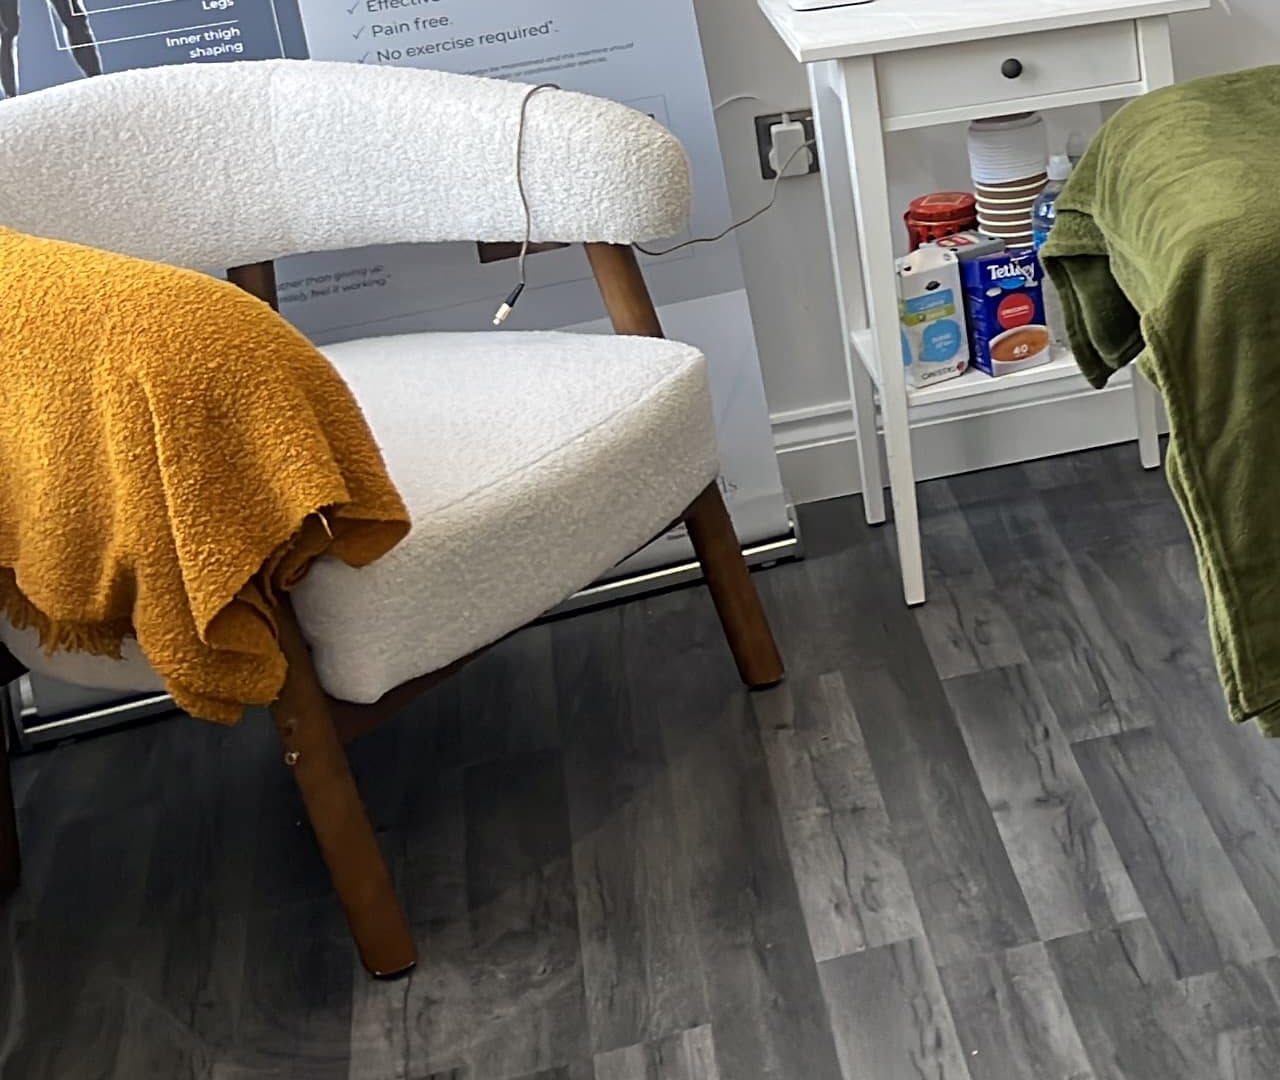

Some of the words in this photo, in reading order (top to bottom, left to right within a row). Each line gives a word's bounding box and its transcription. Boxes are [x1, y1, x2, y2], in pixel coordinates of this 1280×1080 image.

[165, 31, 201, 48] Inner
[203, 25, 241, 44] thigh
[371, 20, 410, 39] Pain
[413, 13, 453, 31] free.
[189, 39, 244, 60] shaping
[376, 45, 402, 63] No
[406, 35, 475, 58] exercise
[1013, 344, 1029, 355] 40
